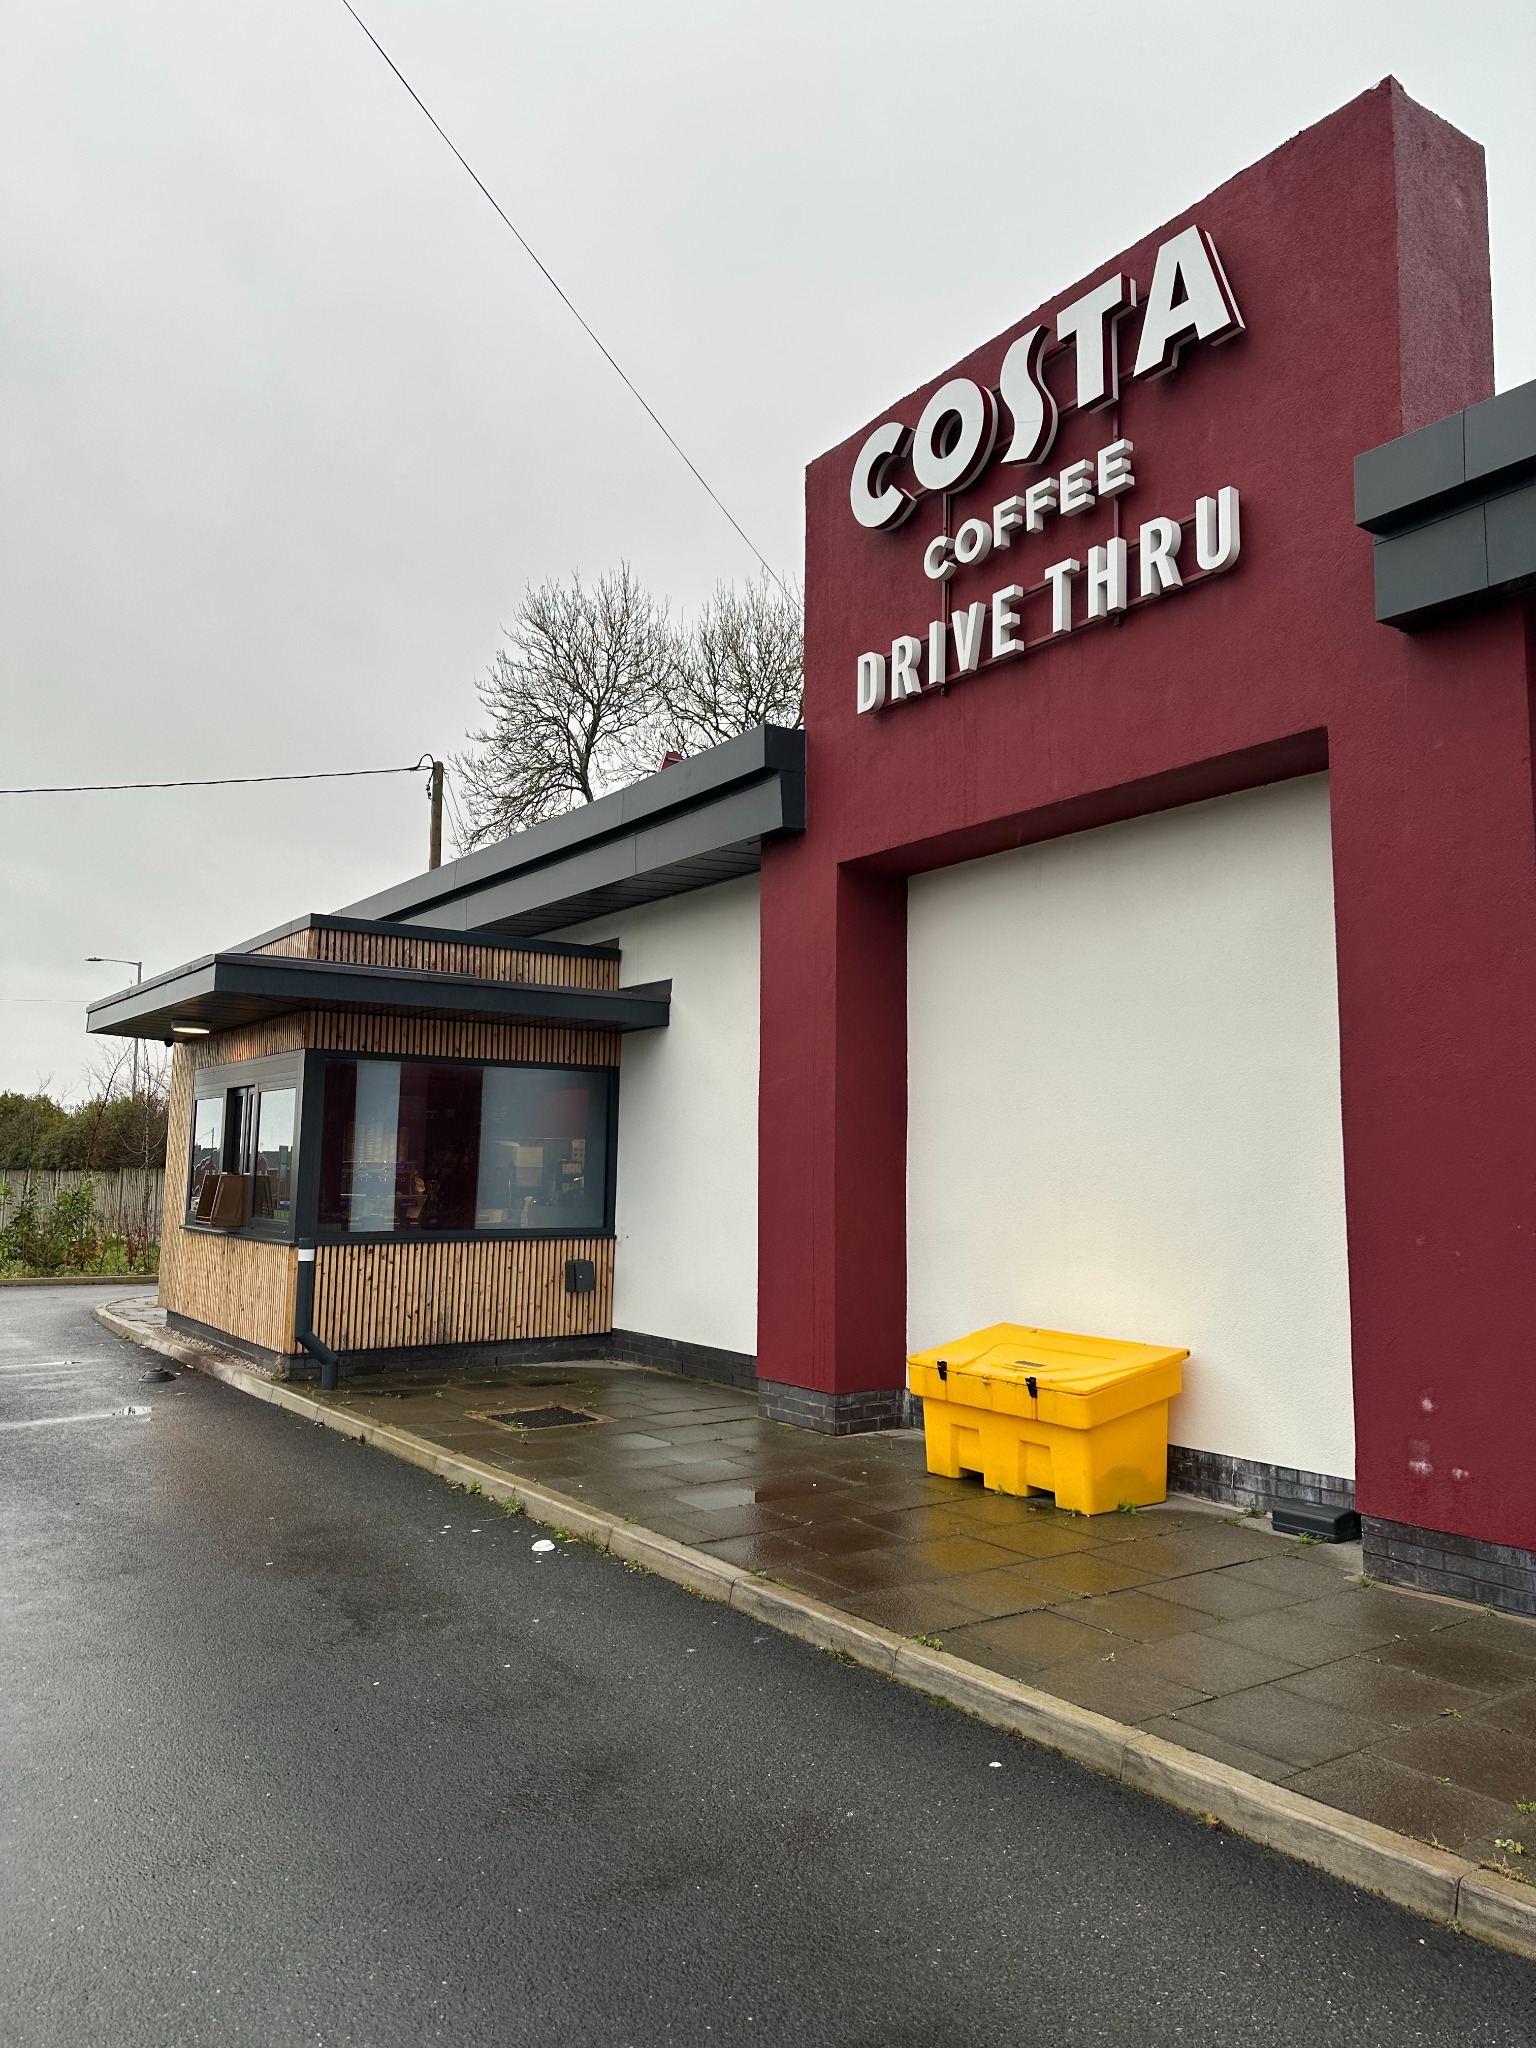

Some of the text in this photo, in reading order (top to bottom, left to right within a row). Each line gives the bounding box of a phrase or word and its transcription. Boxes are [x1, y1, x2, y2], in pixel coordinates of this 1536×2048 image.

[850, 224, 1246, 530] COSTA
[857, 485, 1240, 714] DRIVE THRU
[923, 438, 1135, 581] COFFEE
